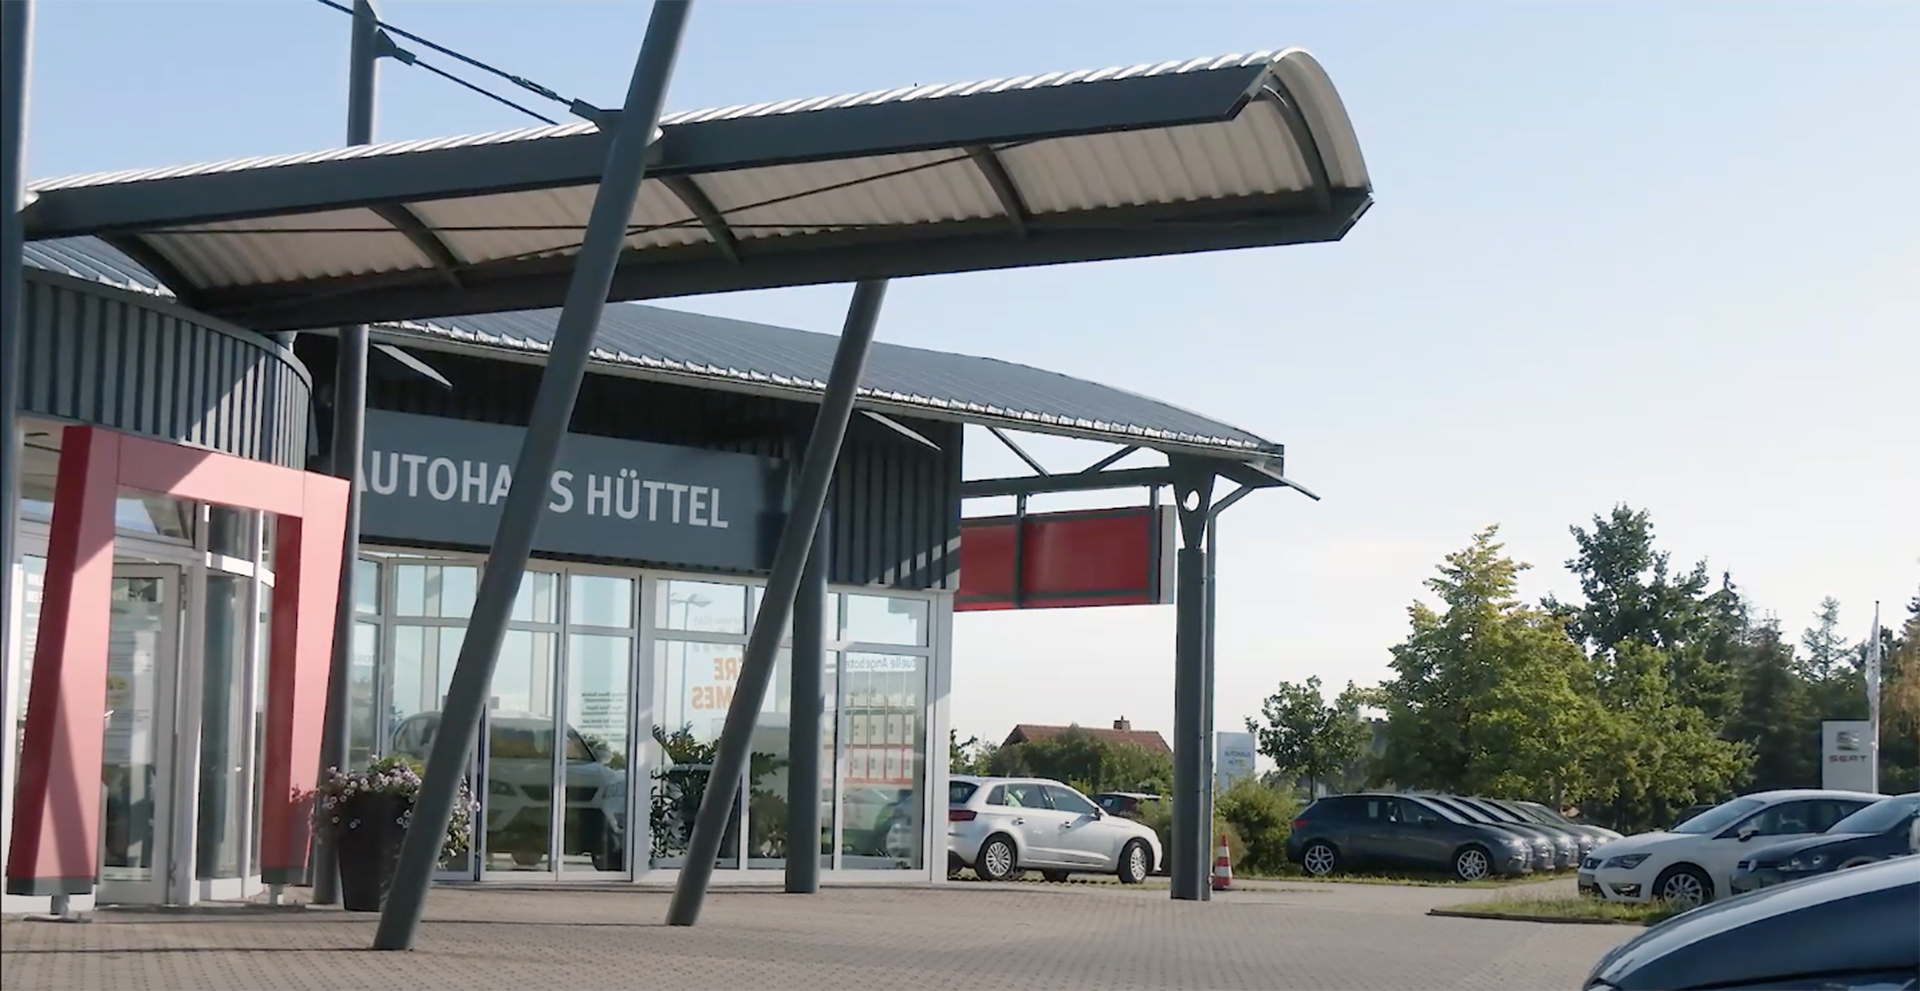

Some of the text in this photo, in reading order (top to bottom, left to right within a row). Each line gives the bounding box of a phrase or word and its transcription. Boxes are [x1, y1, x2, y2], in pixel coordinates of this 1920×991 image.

[360, 450, 729, 529] UTOHAS HÜTTEL
[1829, 754, 1868, 763] SEAT
